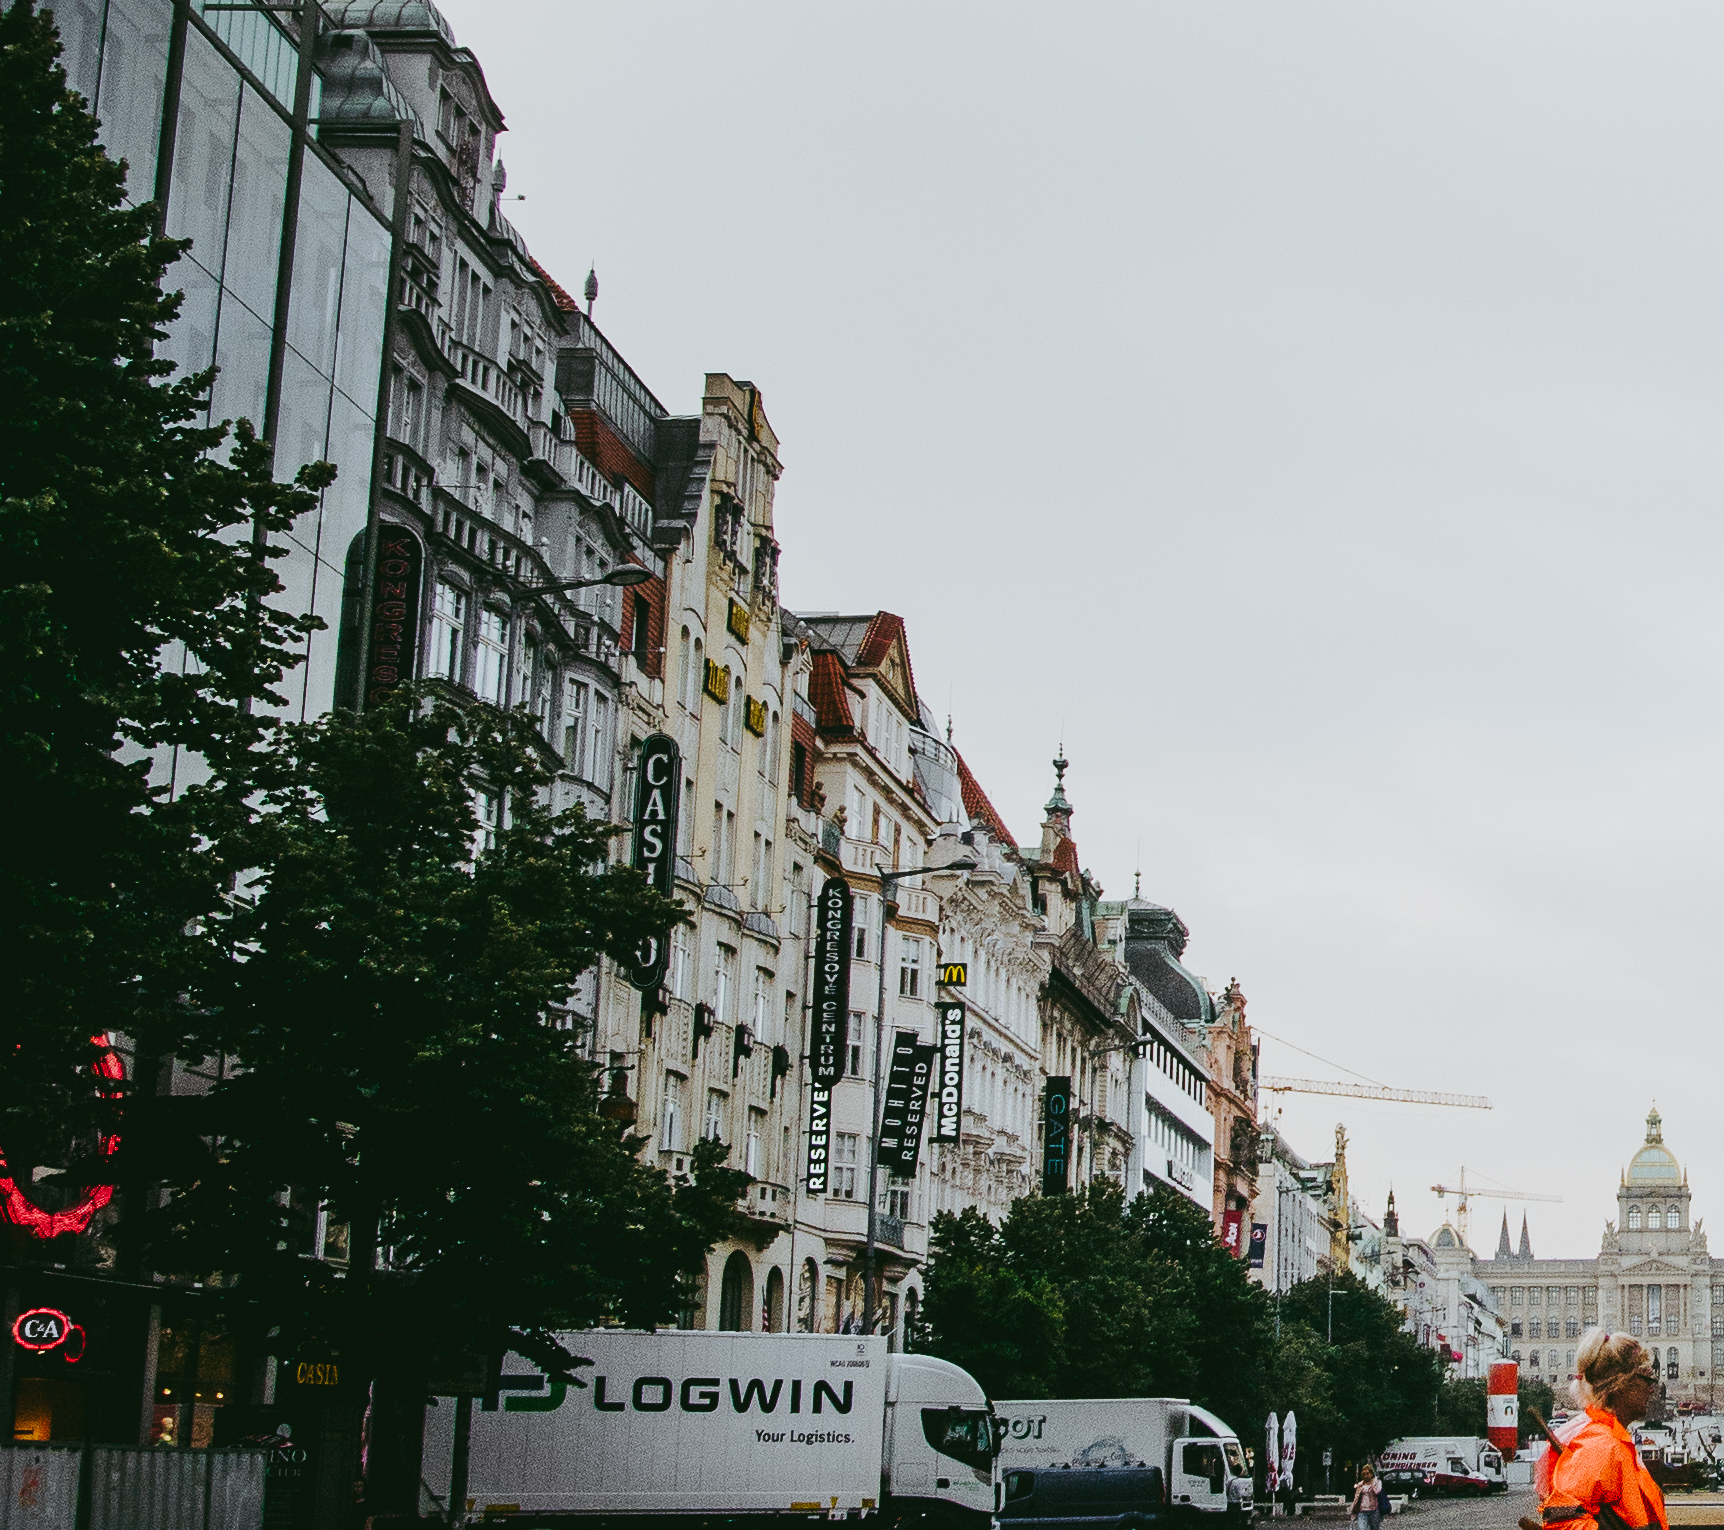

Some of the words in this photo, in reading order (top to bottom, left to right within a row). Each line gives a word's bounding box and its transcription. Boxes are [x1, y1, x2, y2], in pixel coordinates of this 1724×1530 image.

[637, 753, 669, 968] CASIO
[818, 1001, 837, 1076] CENTRUM
[940, 1007, 962, 1137] McDonald's
[809, 1082, 829, 1190] RESERVE
[881, 1046, 914, 1149] MOHITO
[901, 1062, 928, 1161] RESERVED
[1047, 1093, 1066, 1175] GATE
[24, 1319, 59, 1338] C&A
[296, 1362, 339, 1385] CASIN
[593, 1376, 853, 1414] LOGWIN
[755, 1429, 786, 1444] Your
[790, 1429, 855, 1446] Logistics.
